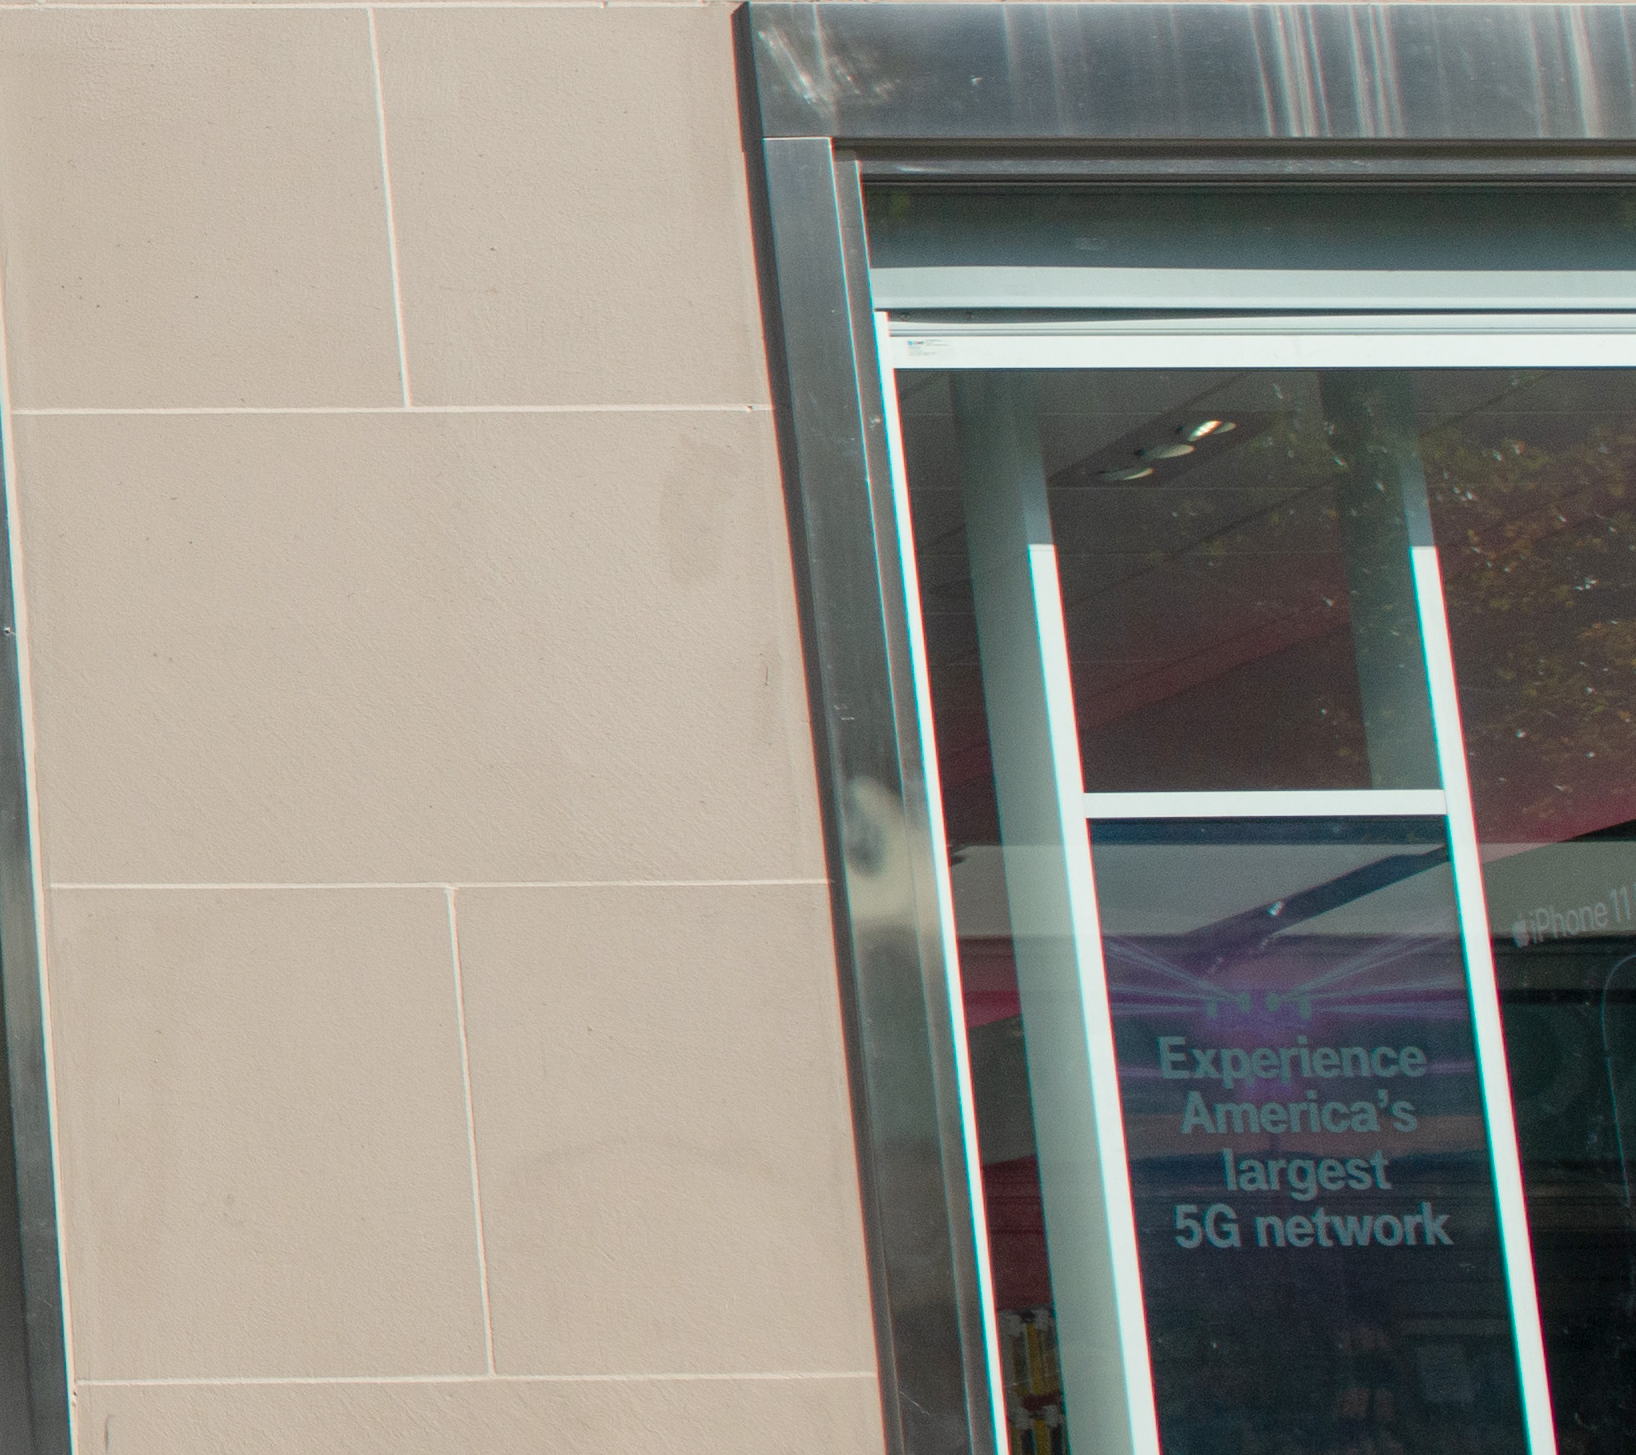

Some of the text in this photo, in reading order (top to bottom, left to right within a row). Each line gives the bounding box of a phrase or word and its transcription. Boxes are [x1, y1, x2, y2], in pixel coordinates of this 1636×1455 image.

[1156, 1036, 1428, 1088] Experience
[1181, 1088, 1418, 1134] America’s
[1222, 1148, 1392, 1201] largest
[1174, 1202, 1454, 1249] 5G network
